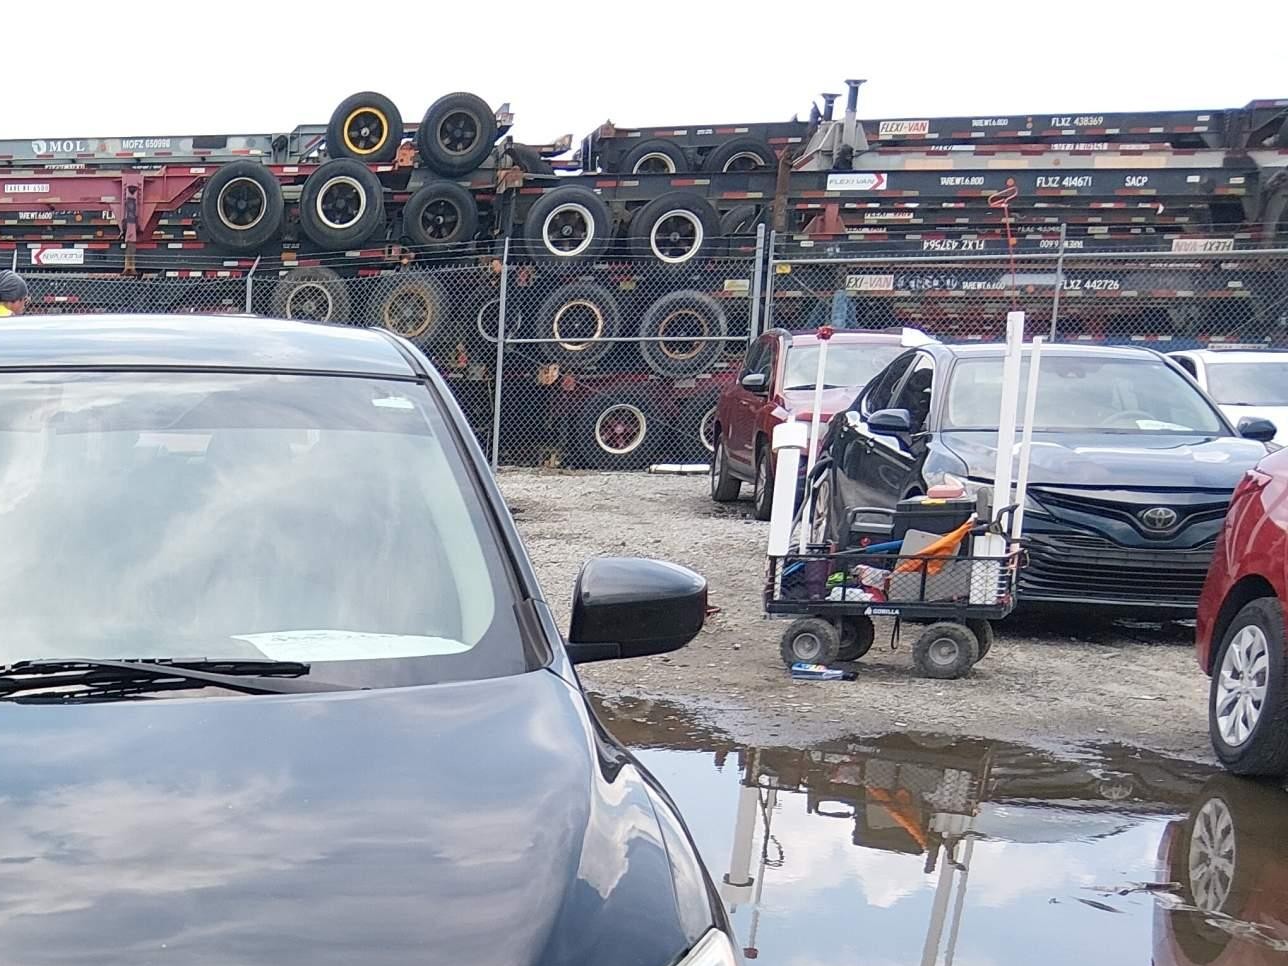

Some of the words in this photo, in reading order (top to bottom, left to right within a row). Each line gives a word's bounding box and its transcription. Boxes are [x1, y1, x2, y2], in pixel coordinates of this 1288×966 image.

[879, 121, 928, 133] FLEXI-VAN
[1051, 117, 1072, 127] FLXZ
[1073, 116, 1104, 127] 438369
[49, 140, 85, 152] MOL
[122, 139, 144, 149] MOFZ
[1036, 176, 1061, 188] FLXZ
[1062, 175, 1093, 188] 414671
[1124, 175, 1149, 187] SACP
[922, 239, 959, 250] 437564
[961, 240, 985, 250] FLXZ
[1173, 240, 1233, 251] FLEXI-VAN
[1084, 279, 1120, 290] 442726
